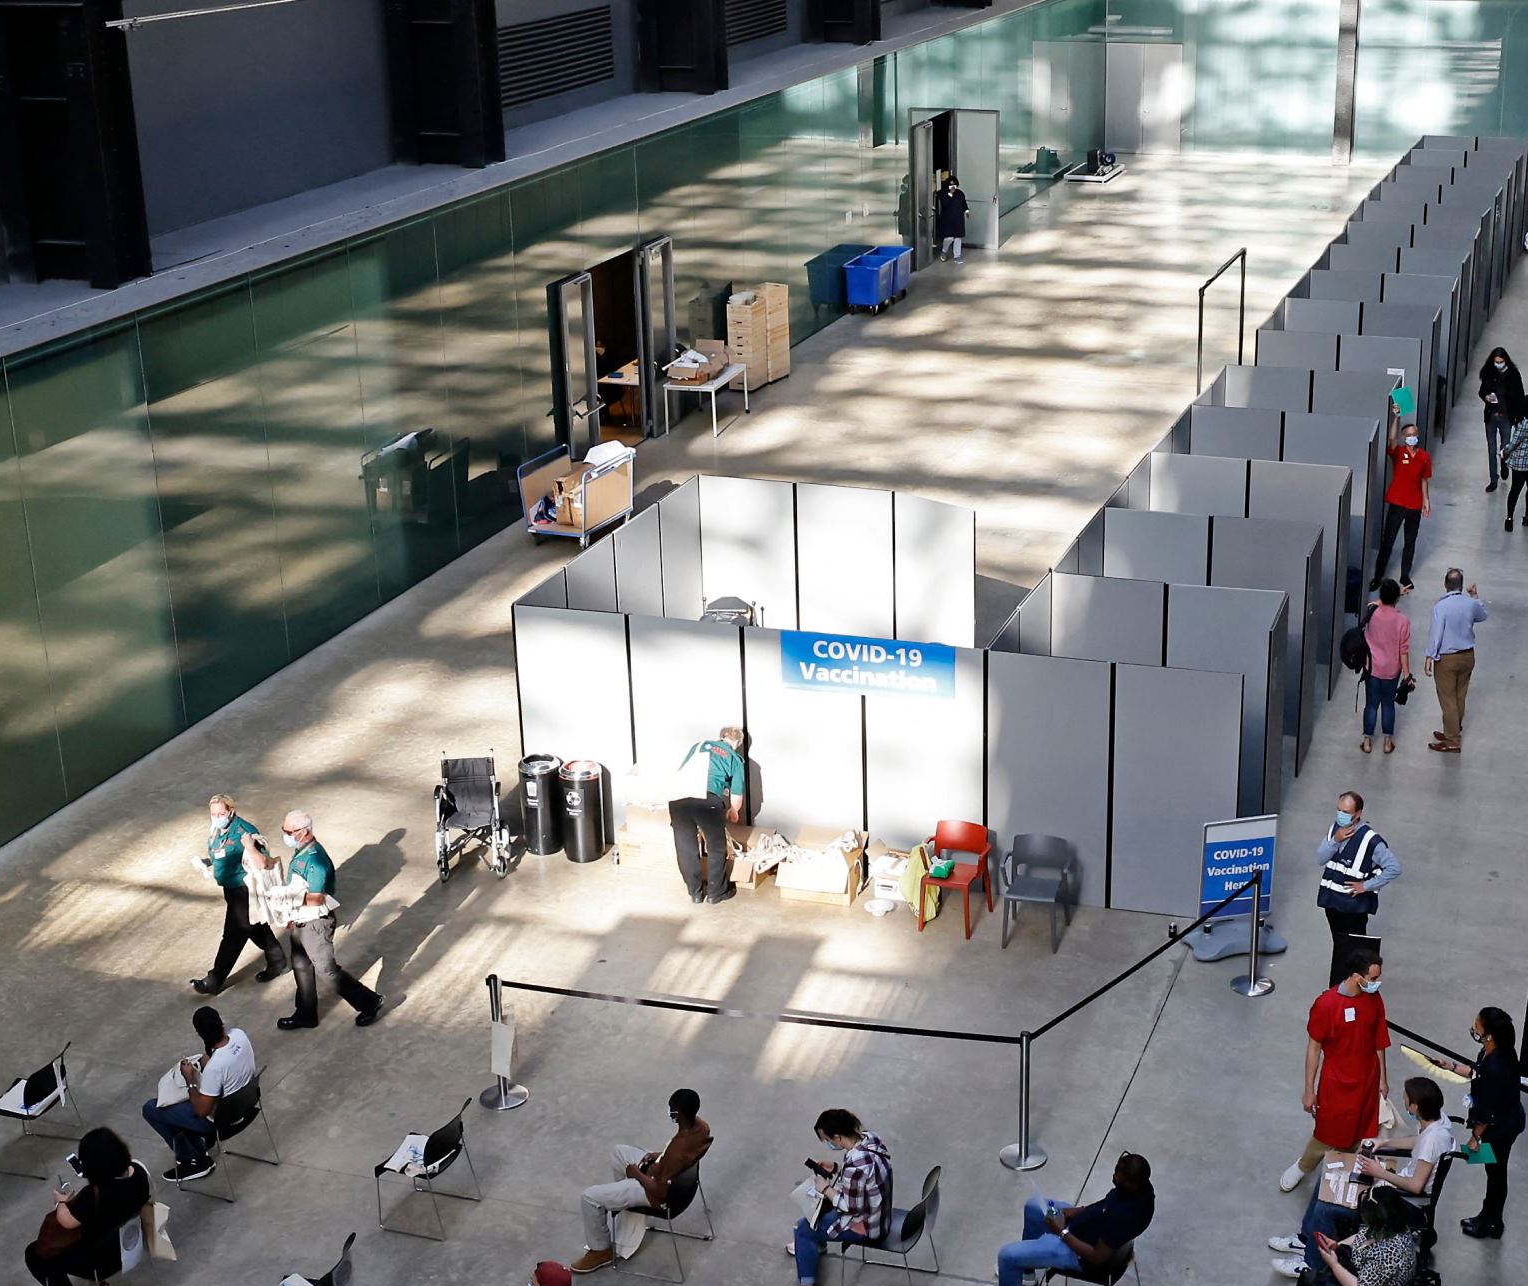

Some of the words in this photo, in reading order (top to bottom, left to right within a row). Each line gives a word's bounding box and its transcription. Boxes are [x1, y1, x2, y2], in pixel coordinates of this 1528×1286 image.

[813, 640, 922, 668] COVID-19
[799, 661, 938, 692] Vaccination
[1213, 846, 1264, 860] COVID-19
[1207, 862, 1270, 877] Vaccination
